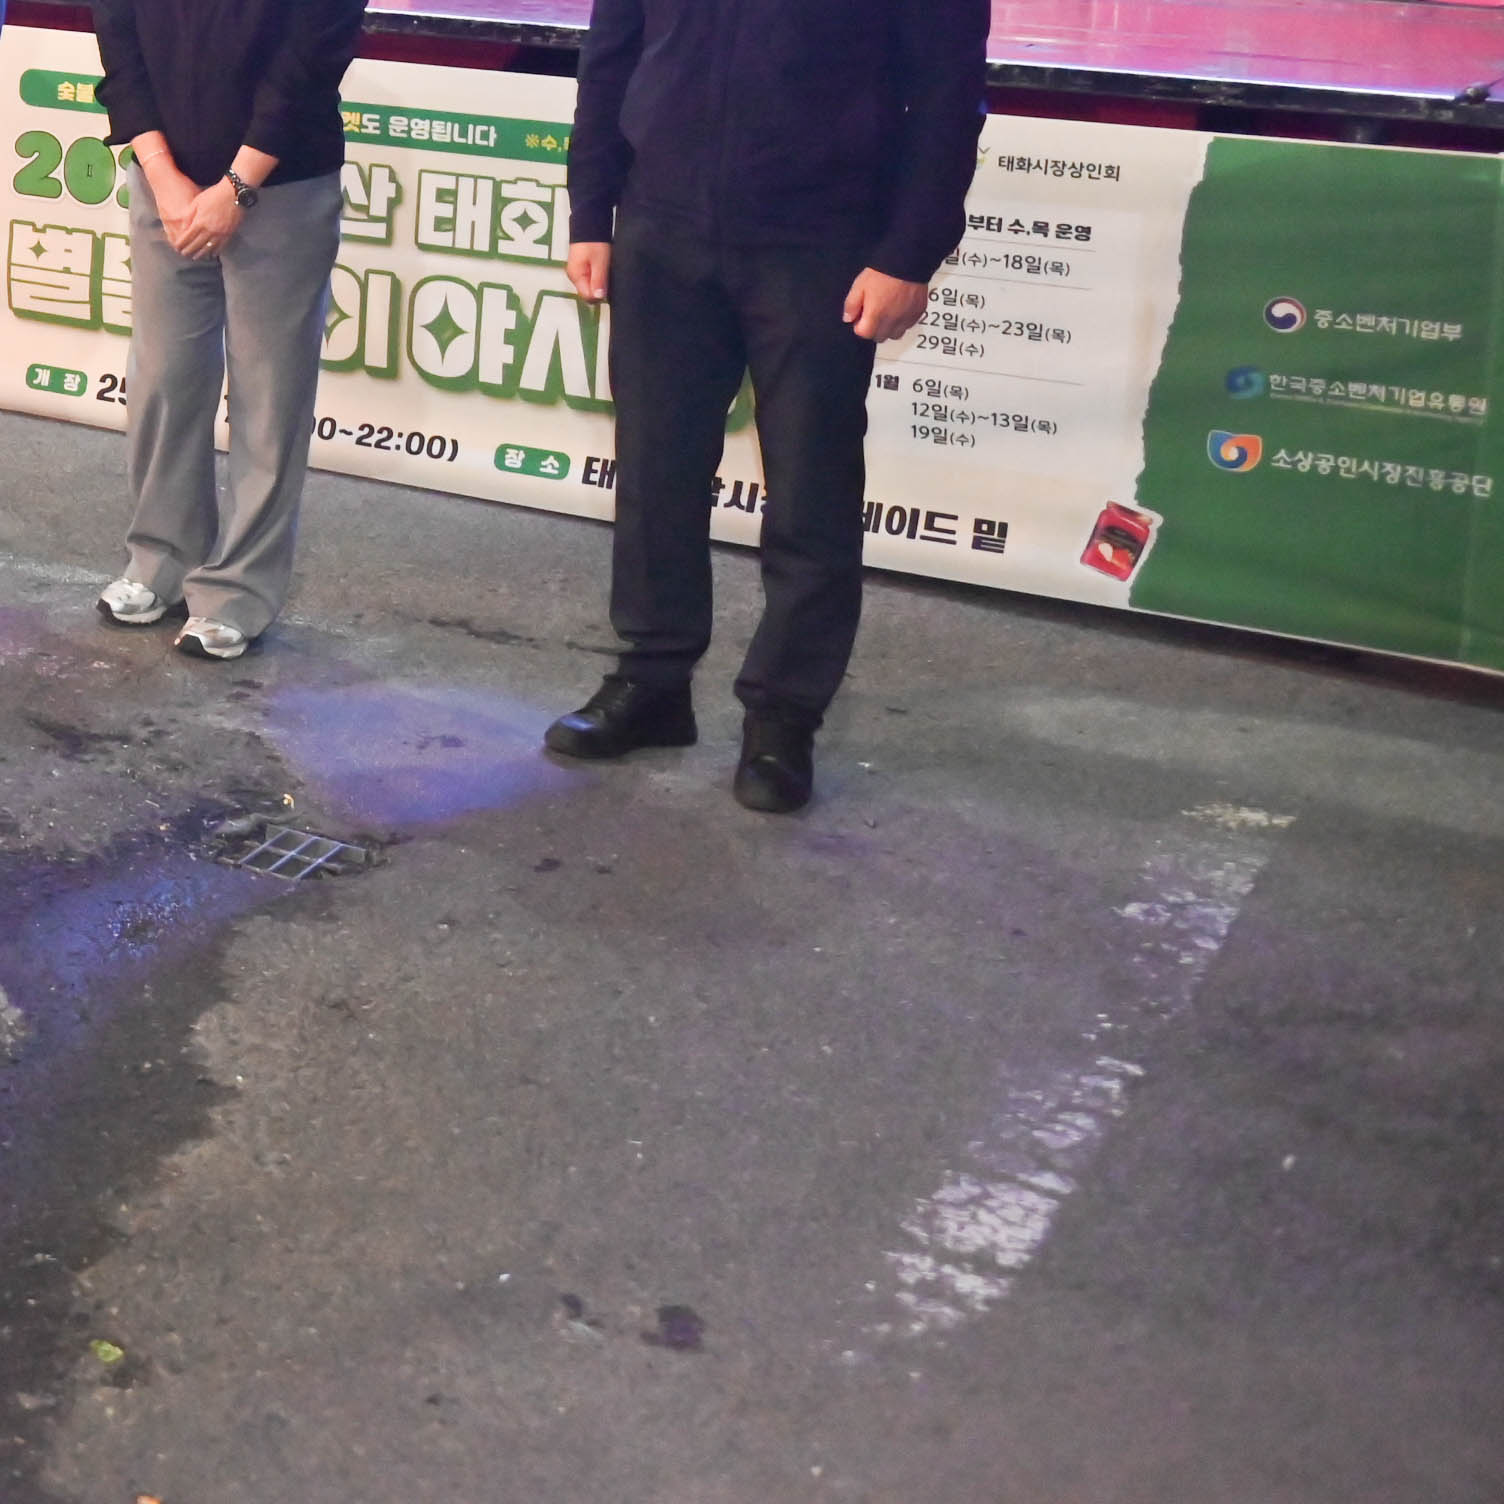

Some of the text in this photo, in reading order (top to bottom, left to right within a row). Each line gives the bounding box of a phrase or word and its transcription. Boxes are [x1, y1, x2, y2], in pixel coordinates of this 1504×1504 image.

[388, 115, 497, 148] 운영됩니다
[997, 154, 1121, 182] 태화시장상인회
[967, 213, 1003, 234] 부터
[1054, 222, 1092, 242] 운영
[944, 248, 1071, 278] 일(수)~18일(목)
[928, 287, 985, 310] 6일(목)
[1313, 309, 1463, 342] 중소벤처기업부
[916, 334, 985, 358] 29일(수)
[912, 377, 970, 401] 6일(목)
[1268, 373, 1488, 416] 한국중소벤처기업유통원
[911, 401, 1058, 436] 12일(수)~13일(목)
[312, 416, 460, 463] 0~22:00)
[911, 424, 976, 448] 19일(수)
[1270, 447, 1494, 498] 소상공인시장진흥공단
[971, 517, 1009, 554] 밑
